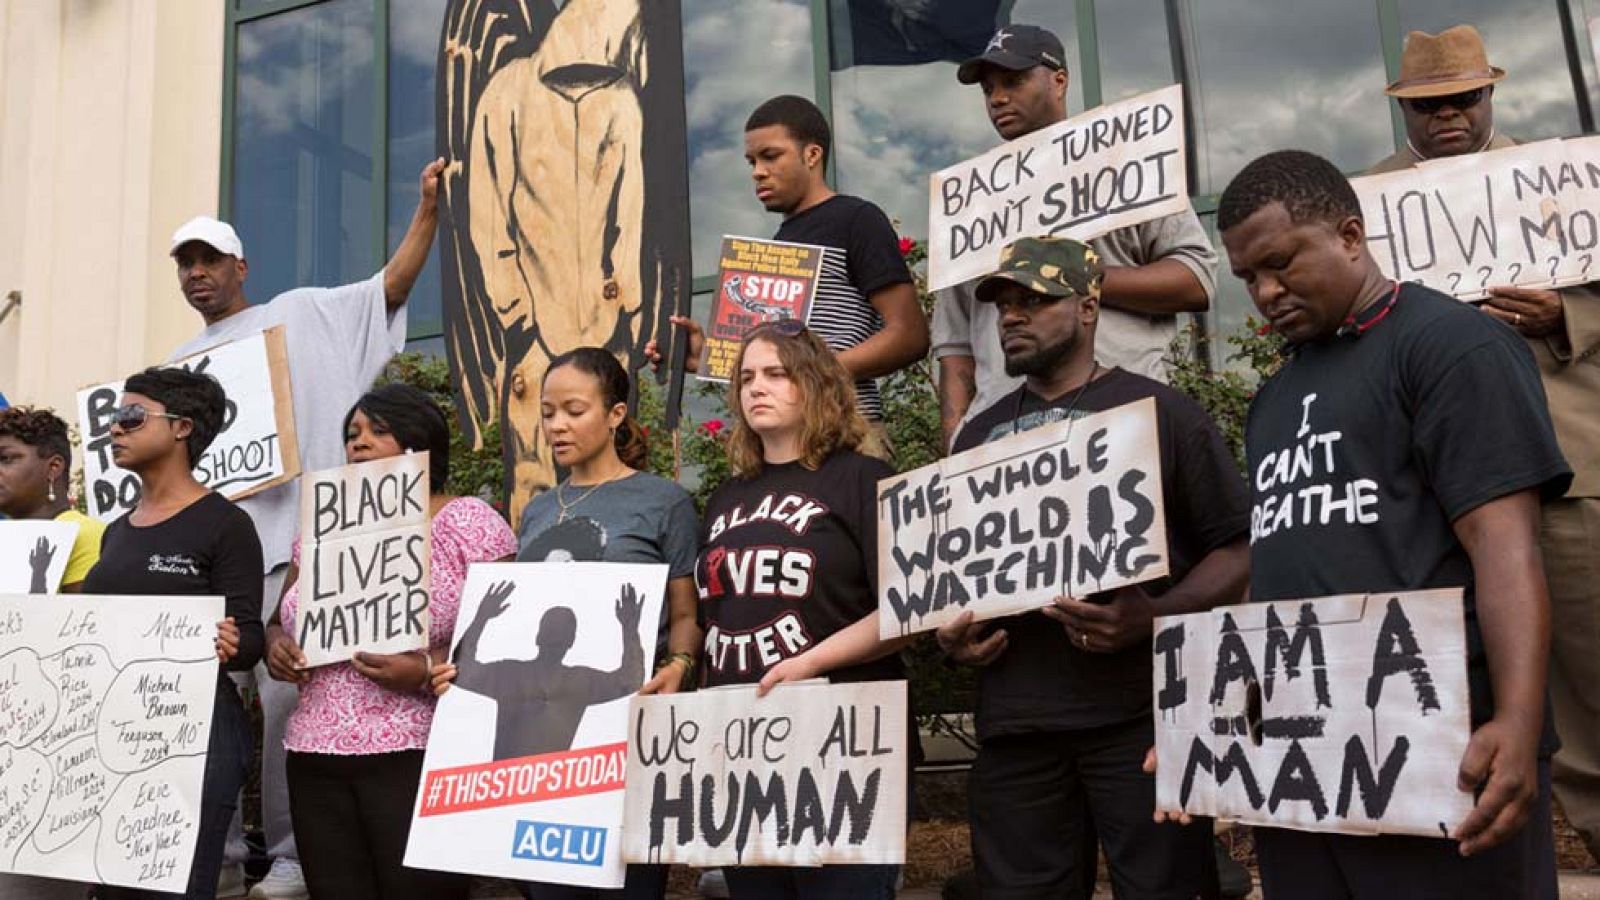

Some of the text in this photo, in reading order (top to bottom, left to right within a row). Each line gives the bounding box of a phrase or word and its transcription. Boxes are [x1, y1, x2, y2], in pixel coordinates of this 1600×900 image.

[942, 104, 1173, 216] BACK TURNED
[950, 149, 1178, 260] DON'T SHOOT
[1366, 162, 1600, 281] HOW MAN
[1519, 209, 1599, 264] MO
[745, 275, 804, 302] STOP
[1297, 393, 1317, 438] I
[196, 433, 278, 484] SHOOT
[880, 428, 1109, 531] THE WHOLE
[1257, 431, 1342, 492] CAN'T
[315, 470, 425, 539] BLACK
[709, 494, 823, 542] BLACK
[892, 469, 1154, 577] WORLD IS
[1250, 478, 1378, 546] REATHE
[313, 534, 424, 601] LIVES
[887, 535, 1161, 623] WATCHING
[59, 609, 97, 638] Life
[300, 588, 429, 652] MATTER
[705, 613, 808, 671] ATTER
[1154, 597, 1440, 716] I AM A
[636, 705, 893, 767] We are ALL
[650, 766, 881, 848] HUMAN
[1181, 734, 1409, 821] MAN
[138, 857, 176, 882] 2014
[517, 825, 602, 861] ACLU
